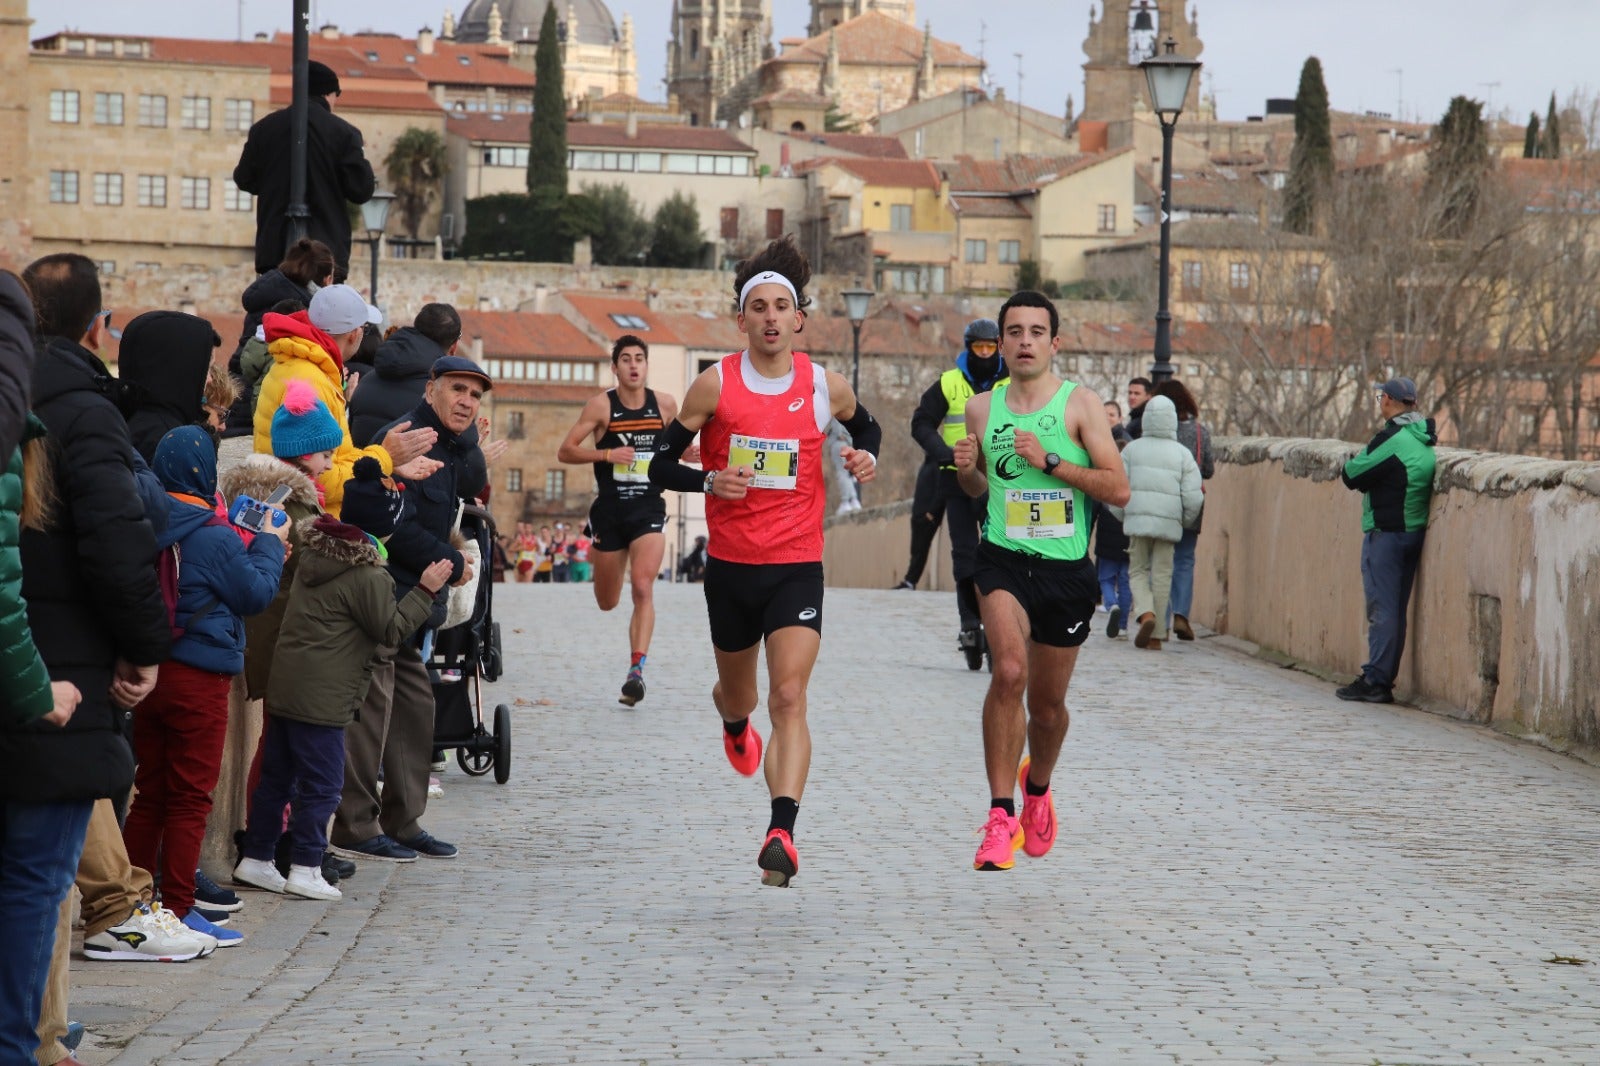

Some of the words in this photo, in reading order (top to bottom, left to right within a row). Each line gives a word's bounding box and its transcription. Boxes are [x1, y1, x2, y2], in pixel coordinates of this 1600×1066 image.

[748, 439, 793, 451] SETEL
[753, 451, 766, 471] 3
[1022, 492, 1067, 501] SETEL
[1030, 502, 1041, 522] 5
